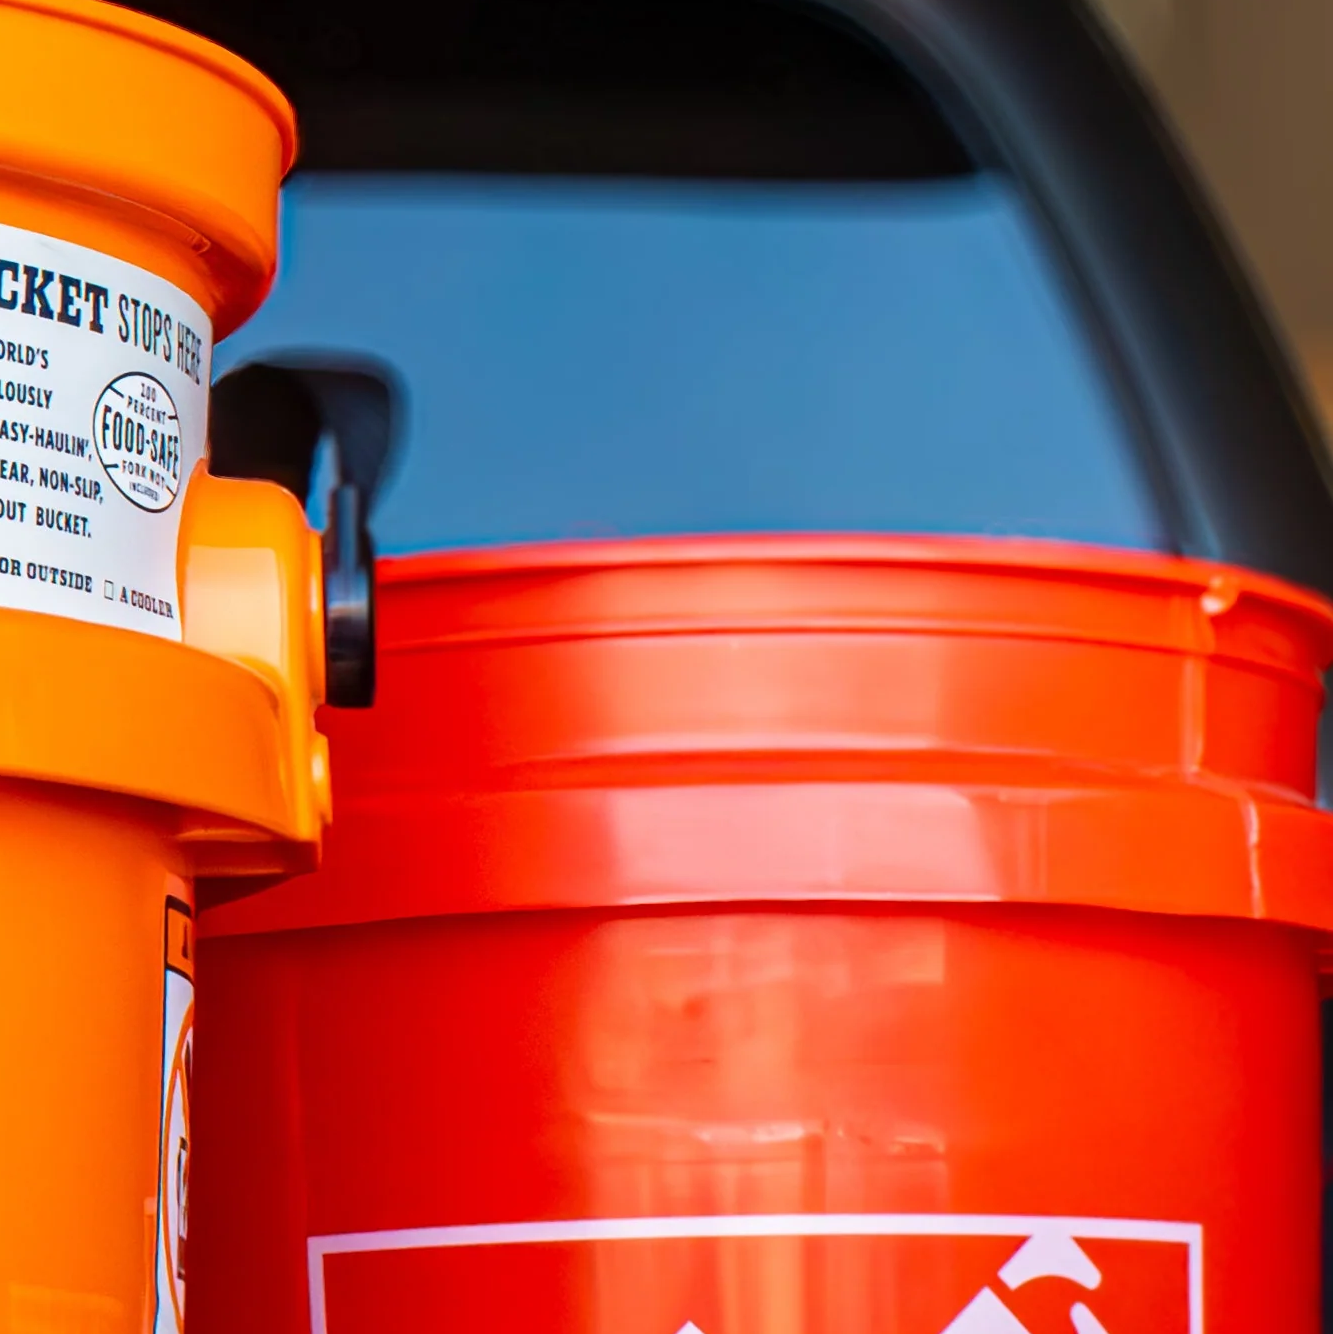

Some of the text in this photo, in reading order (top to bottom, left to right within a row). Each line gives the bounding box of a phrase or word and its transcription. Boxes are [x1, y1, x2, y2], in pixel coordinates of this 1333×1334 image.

[118, 293, 172, 362] STOPS
[126, 394, 167, 426] PERCENT
[101, 403, 179, 480] FOOD-SAFE
[39, 466, 104, 505] NON-SLIP,
[121, 460, 166, 491] FORK NOT
[35, 505, 92, 539] BUCKET.
[26, 562, 93, 593] OUTSIDE
[119, 586, 129, 604] A
[131, 590, 174, 619] COOLER
